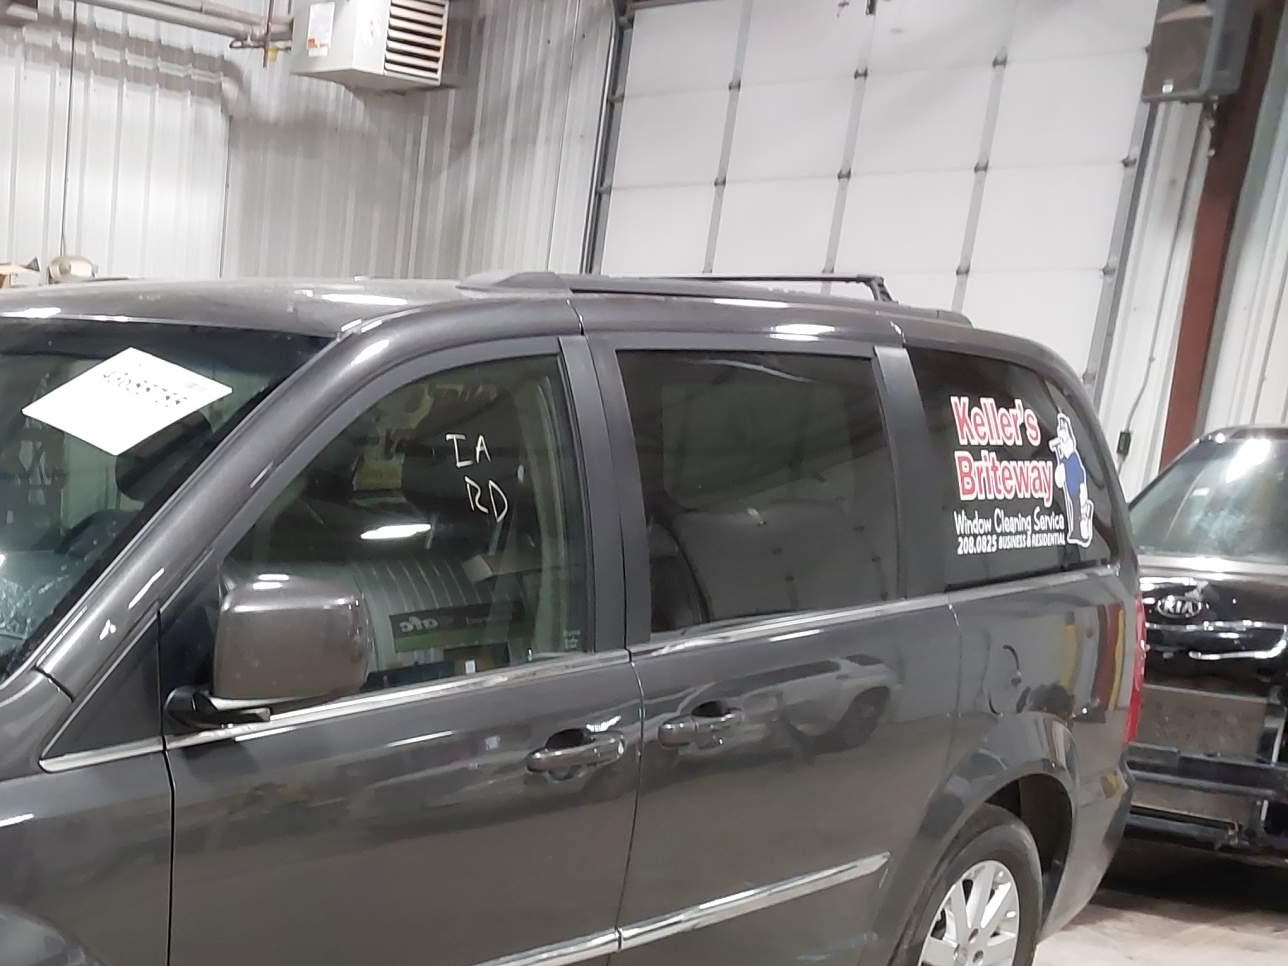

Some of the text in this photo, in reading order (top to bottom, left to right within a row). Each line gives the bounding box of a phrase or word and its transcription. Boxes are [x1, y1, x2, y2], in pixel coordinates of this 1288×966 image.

[950, 395, 1041, 446] Keller's
[954, 449, 1053, 508] Briteway
[464, 475, 508, 523] RD
[954, 506, 1065, 535] Window Cleaning Service
[957, 534, 998, 555] 208.0825
[998, 534, 1026, 549] BUSINESS
[1032, 532, 1066, 547] RESIDENTIAL
[1162, 599, 1194, 614] KIA
